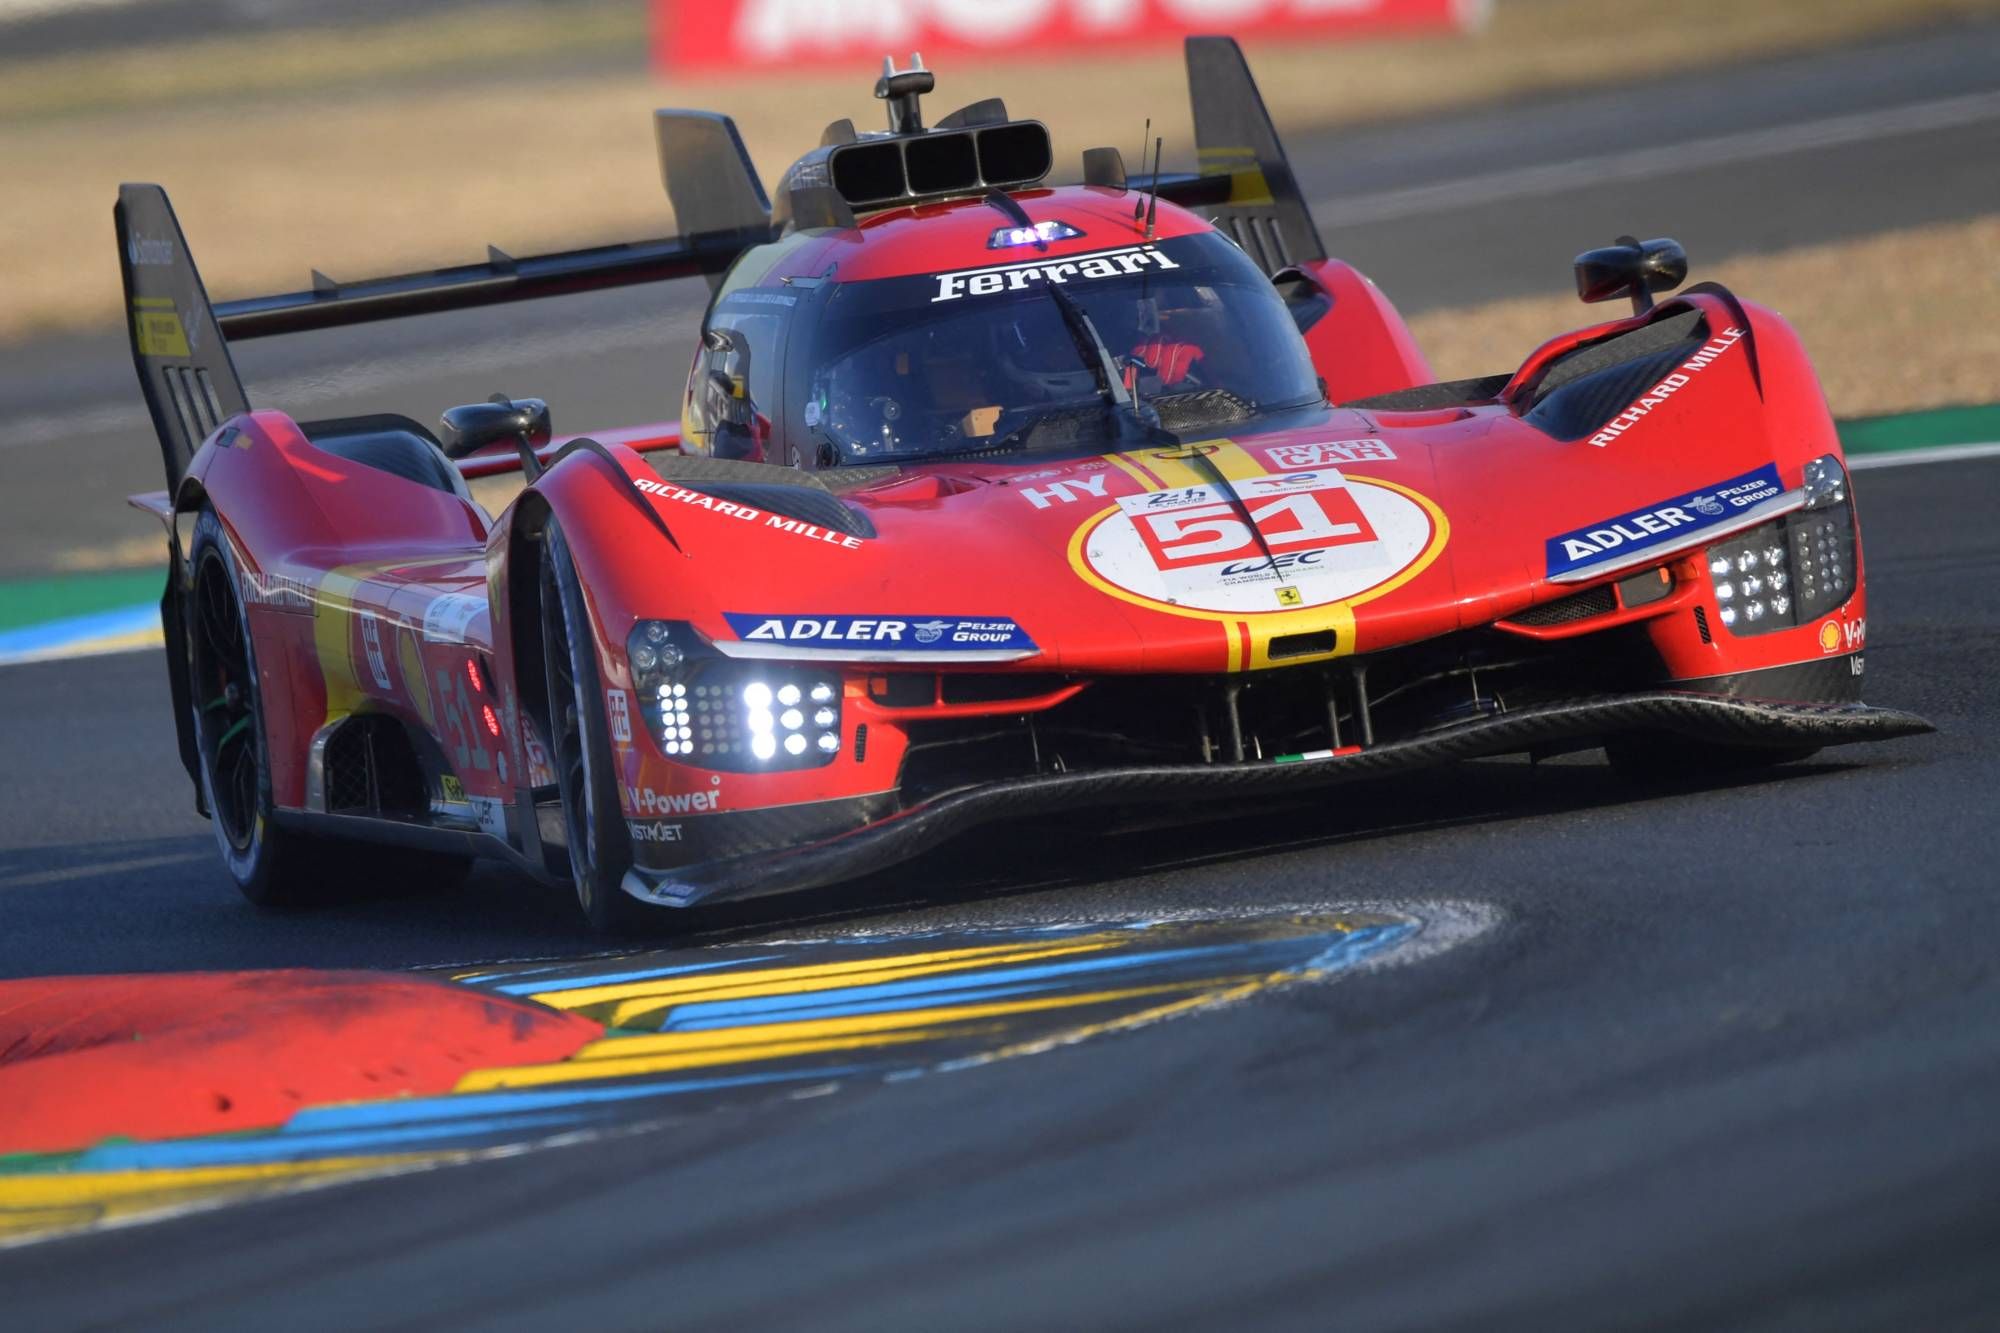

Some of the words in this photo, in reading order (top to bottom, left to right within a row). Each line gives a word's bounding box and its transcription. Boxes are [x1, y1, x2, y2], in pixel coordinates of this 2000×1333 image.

[931, 245, 1181, 302] Ferrari
[1588, 373, 1691, 447] RICHARD
[1682, 327, 1747, 372] MILLE
[1269, 440, 1379, 456] HYPER
[1281, 447, 1390, 466] CAR
[1020, 473, 1109, 509] HY
[1729, 486, 1779, 507] GROUP
[632, 478, 759, 521] RICHARD
[765, 515, 864, 550] MILLE
[1145, 493, 1362, 560] 51
[1560, 506, 1698, 562] ADLER
[1716, 478, 1768, 500] PELZER
[745, 620, 907, 642] ADLER
[956, 621, 1016, 632] PELZER
[952, 631, 1012, 643] GROUP
[628, 787, 720, 815] V-Power
